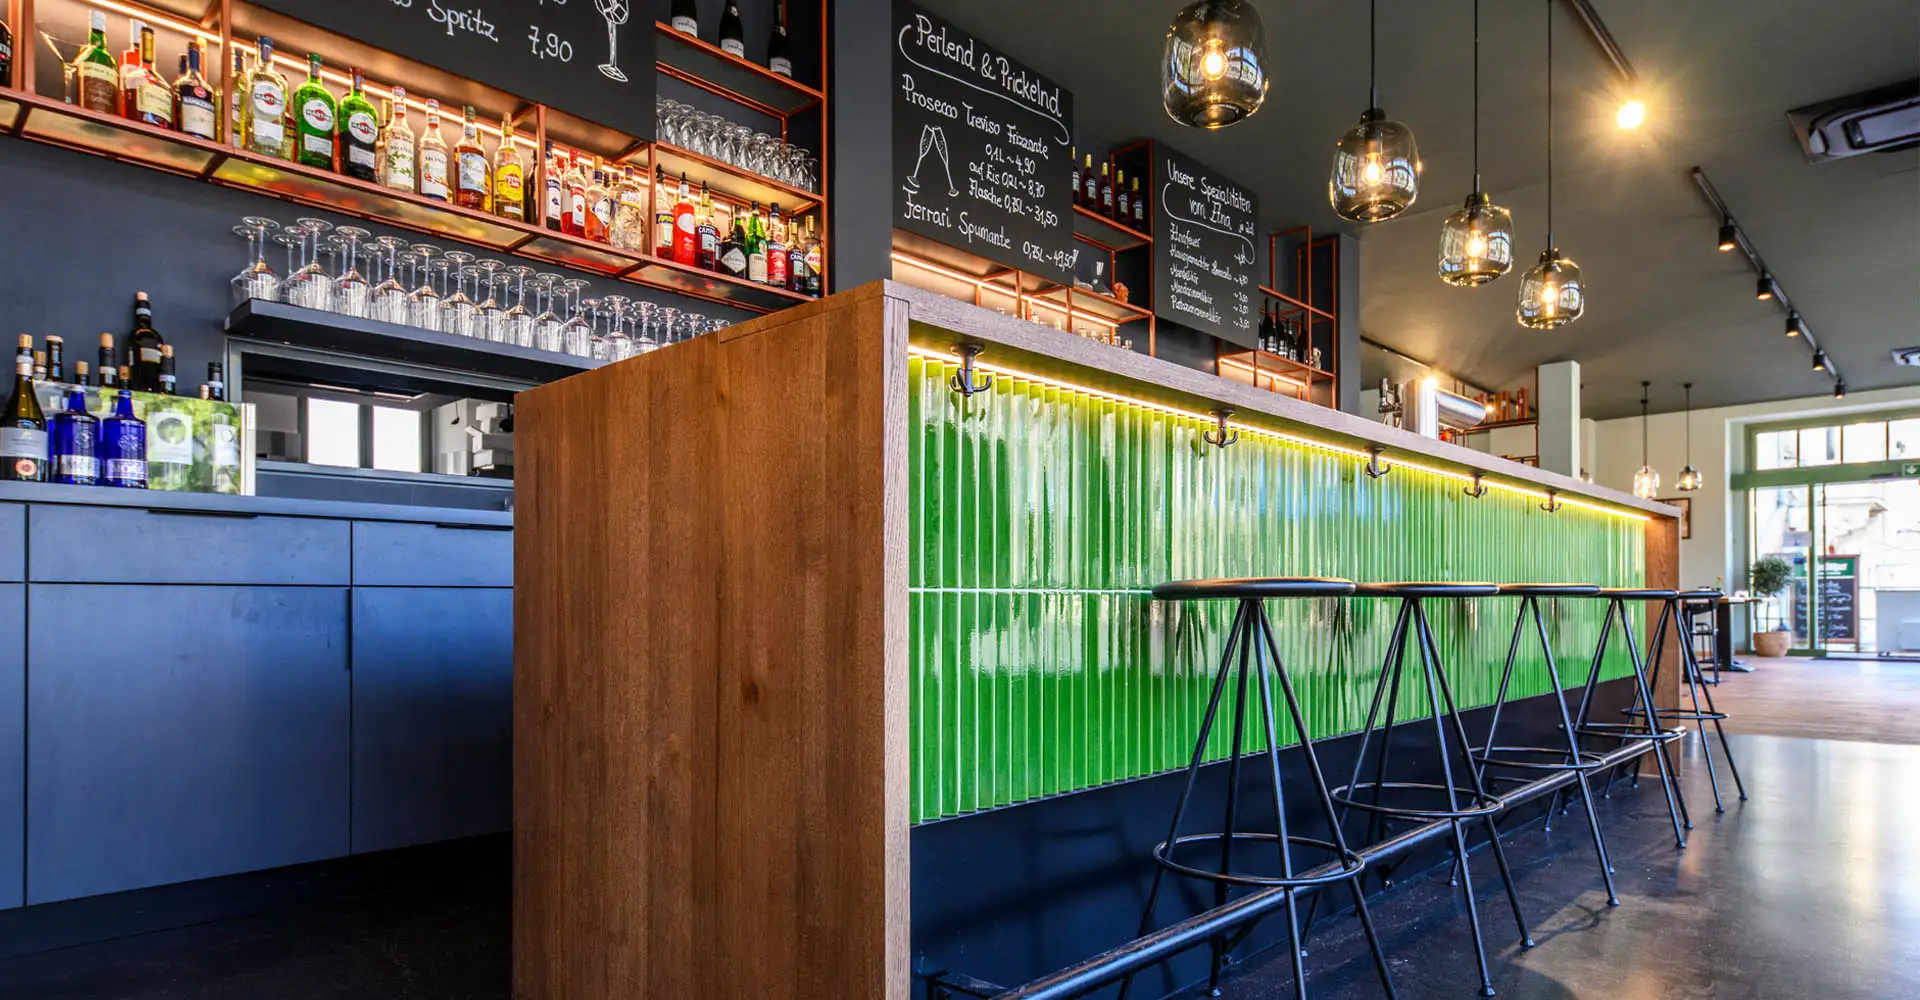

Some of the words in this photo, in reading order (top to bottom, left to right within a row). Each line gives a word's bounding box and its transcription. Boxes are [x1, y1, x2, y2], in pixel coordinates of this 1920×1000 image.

[427, 0, 499, 42] Spritz
[528, 25, 573, 62] 7,90
[915, 14, 976, 71] Perlend
[981, 53, 996, 80] &
[996, 57, 1062, 118] Prickelnd
[902, 73, 958, 119] Prosecco
[962, 102, 1001, 135] Treviso
[1006, 124, 1049, 160] Frizzante
[968, 161, 985, 181] auf
[986, 164, 1000, 185] Eis
[1028, 181, 1045, 199] 8,70
[1015, 155, 1036, 176] 4,90
[1167, 158, 1196, 190] Unsere
[968, 177, 1003, 208] Flasche
[1004, 195, 1026, 216] 0,75L
[1034, 205, 1058, 228] 31,50
[1189, 197, 1207, 220] vom
[903, 185, 952, 228] Ferrari
[958, 211, 1012, 250] Spumante
[1022, 241, 1045, 263] 0,75L
